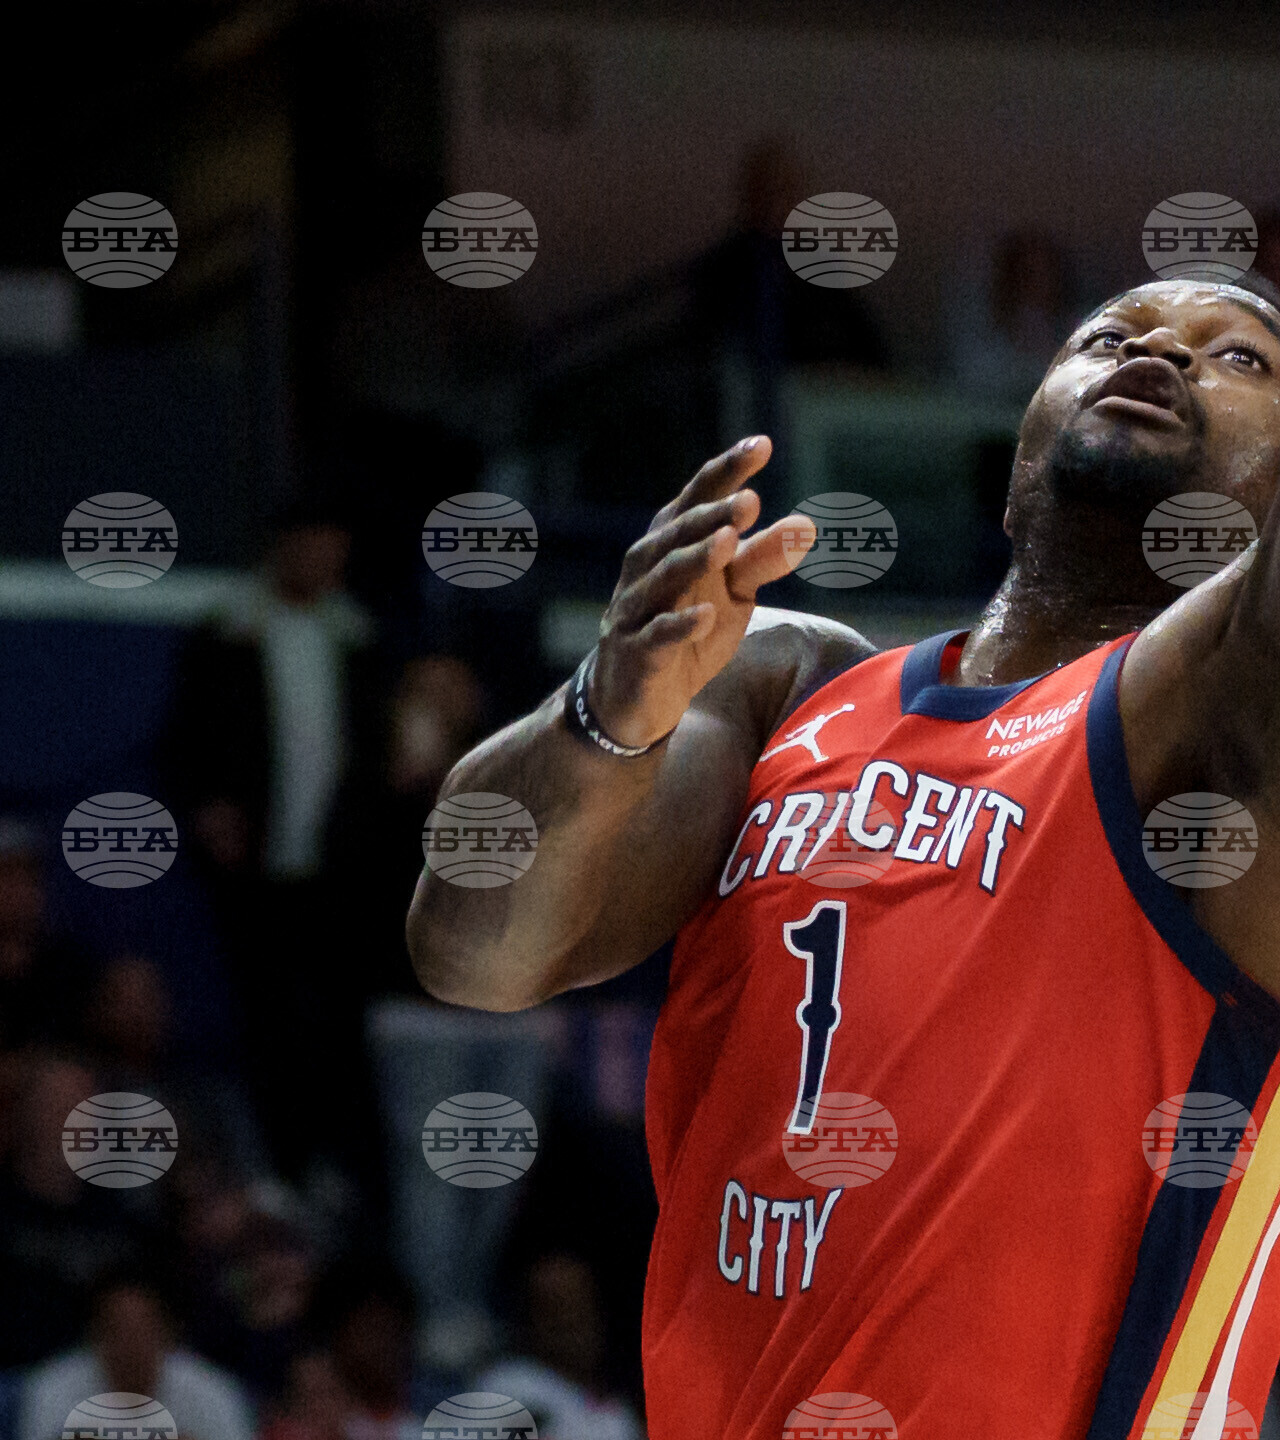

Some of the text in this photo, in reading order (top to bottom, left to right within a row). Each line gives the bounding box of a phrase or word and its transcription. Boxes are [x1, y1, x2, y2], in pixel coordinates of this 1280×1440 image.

[984, 690, 1088, 741] NEWAGE
[987, 721, 1067, 758] PRODUCTS
[783, 900, 849, 1136] 1
[716, 1179, 845, 1298] CITY
